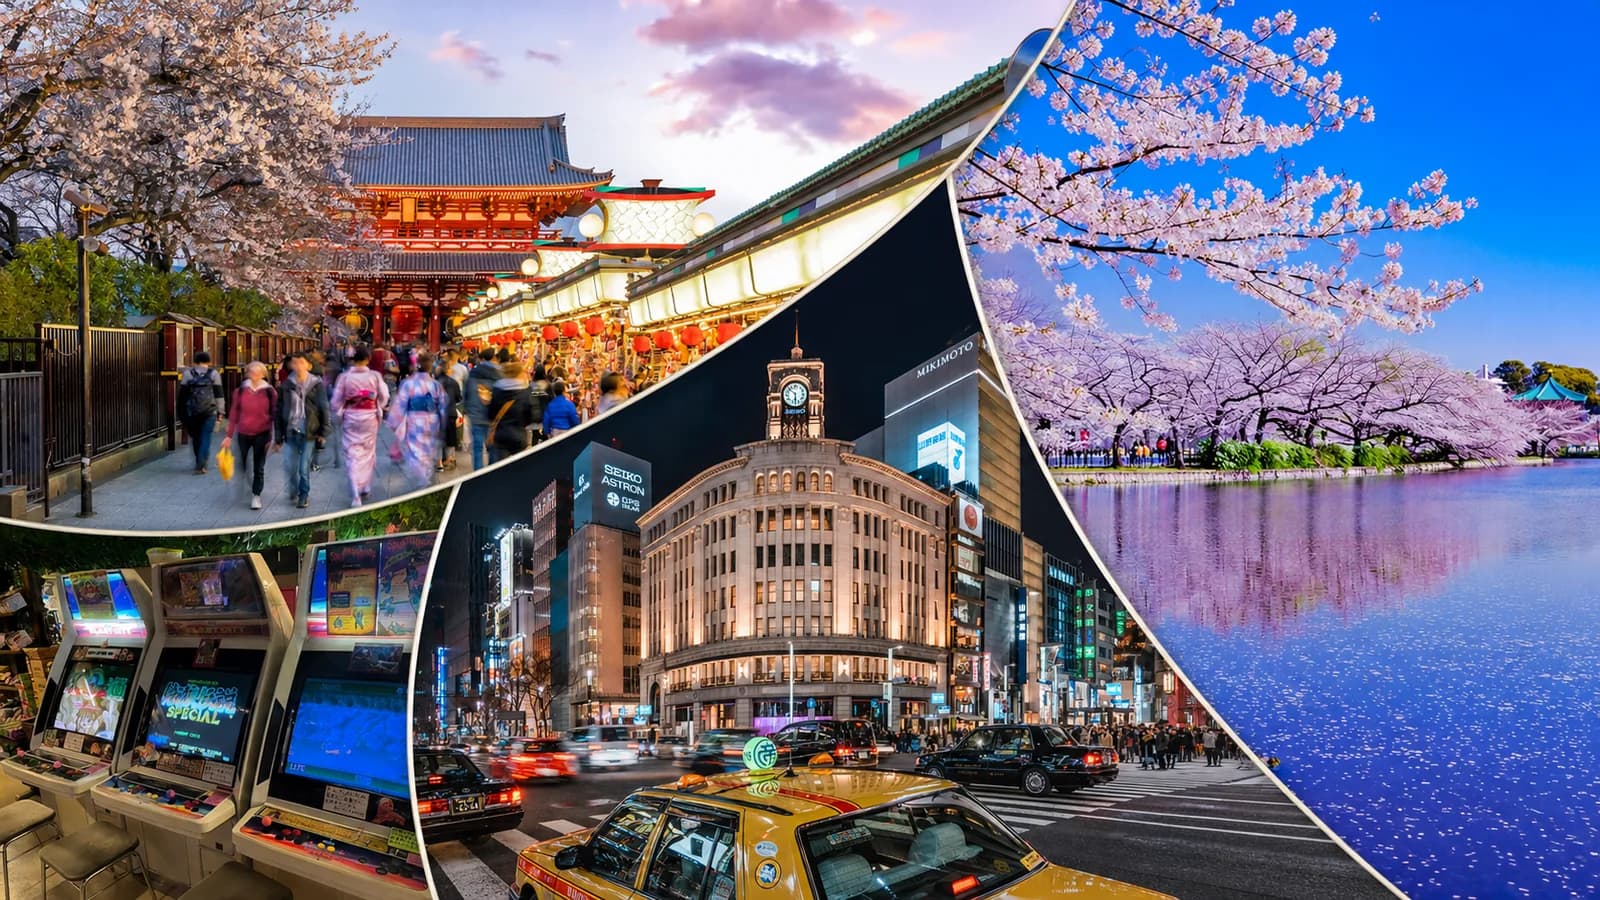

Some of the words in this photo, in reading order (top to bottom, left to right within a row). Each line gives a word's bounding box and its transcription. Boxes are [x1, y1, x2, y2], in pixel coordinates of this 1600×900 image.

[916, 341, 974, 379] MIKIMOTO
[604, 464, 642, 484] SEIKO
[601, 475, 645, 497] ASTRON
[166, 705, 221, 726] SPECIAL
